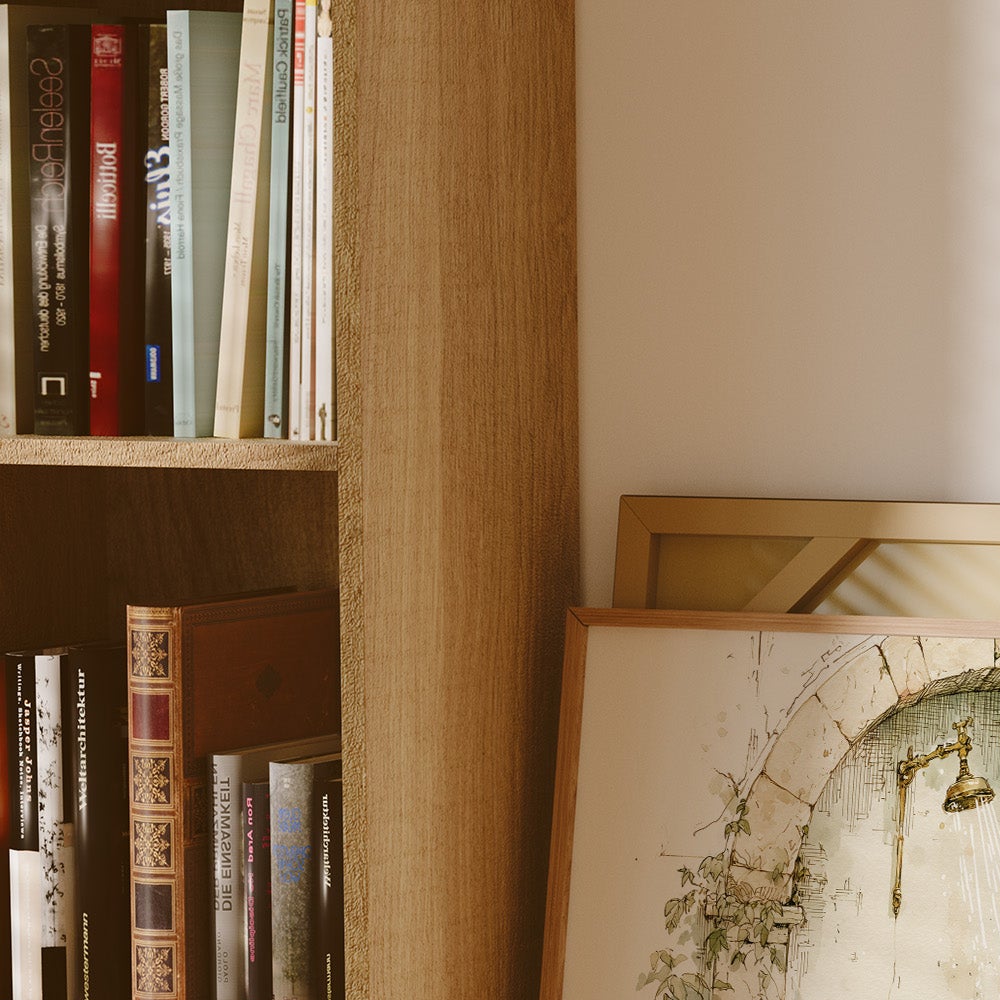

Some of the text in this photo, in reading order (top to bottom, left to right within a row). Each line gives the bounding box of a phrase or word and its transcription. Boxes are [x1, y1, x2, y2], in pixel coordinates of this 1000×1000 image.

[23, 699, 34, 803] Jasper Johns
[76, 668, 90, 813] Weltarchitektur
